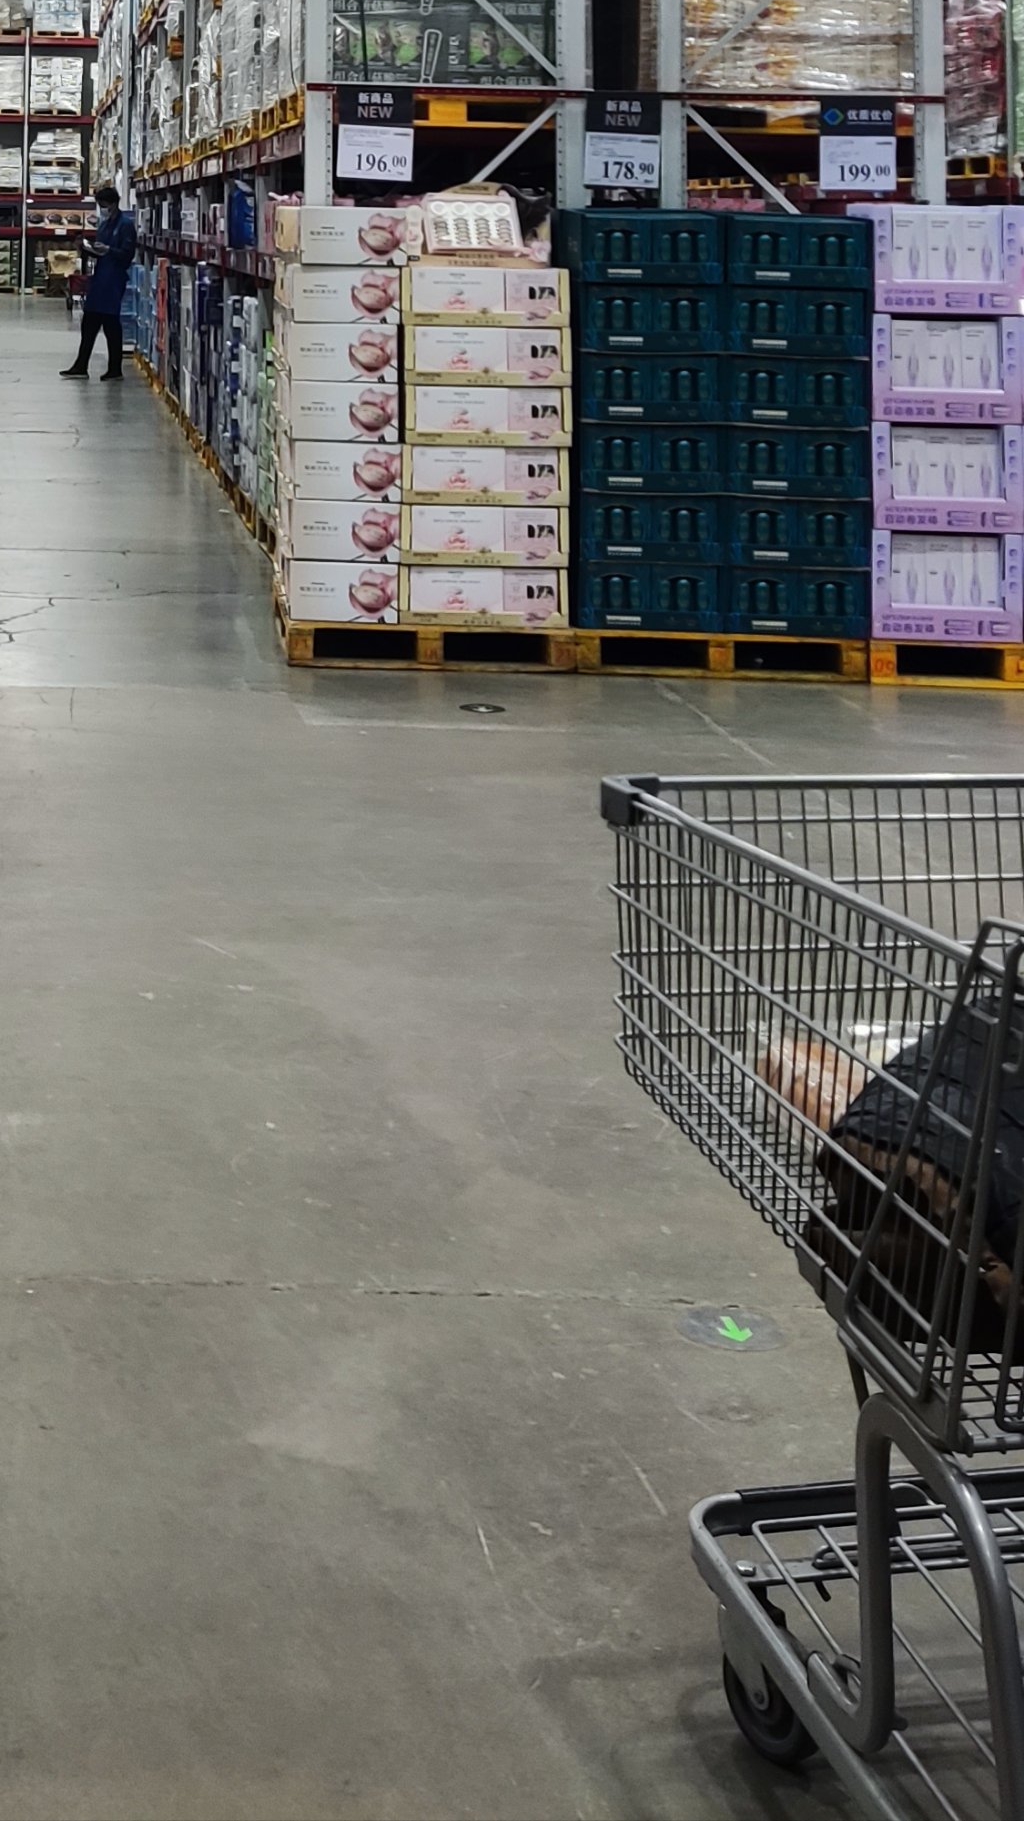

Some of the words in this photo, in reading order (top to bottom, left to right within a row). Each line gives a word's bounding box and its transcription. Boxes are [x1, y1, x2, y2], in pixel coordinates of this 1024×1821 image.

[358, 92, 394, 104] 新商品
[357, 106, 393, 118] NEW
[606, 100, 642, 113] 新商品
[605, 113, 642, 127] NEW
[847, 109, 893, 121] 优质优价
[356, 153, 407, 173] 196.00
[602, 160, 655, 181] 178.90
[838, 164, 891, 183] 199.00
